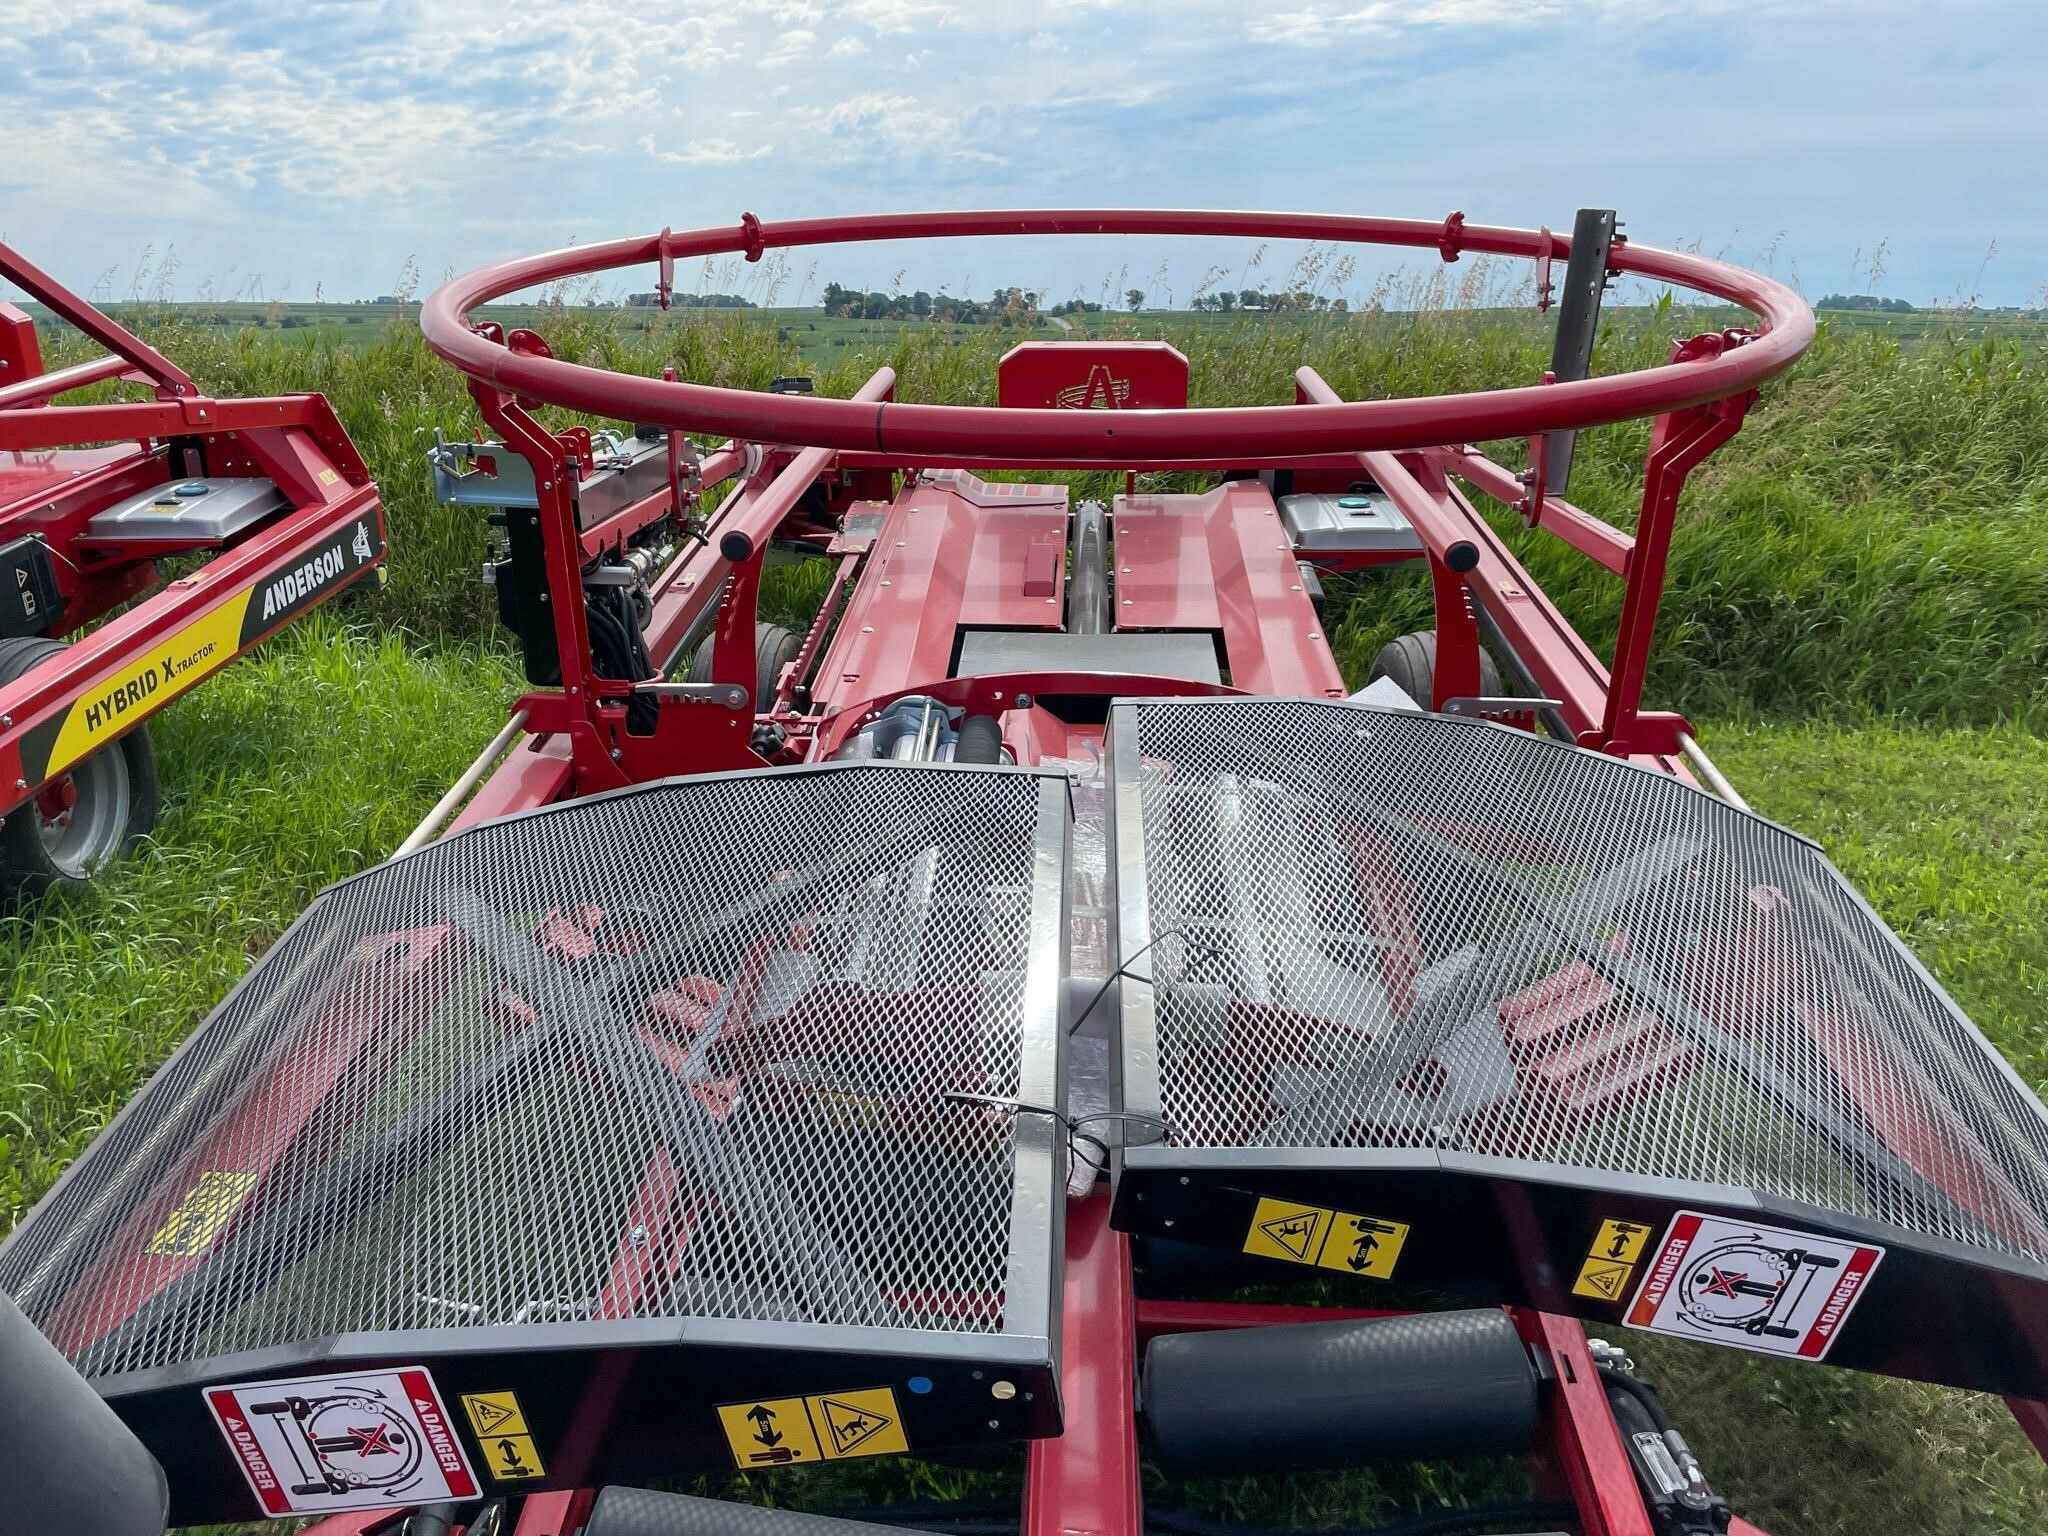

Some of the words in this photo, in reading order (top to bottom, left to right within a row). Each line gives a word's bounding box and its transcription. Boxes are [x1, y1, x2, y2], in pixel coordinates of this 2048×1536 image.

[262, 544, 345, 621] ANDERSON
[85, 668, 158, 733] HYBRID
[1649, 1238, 1689, 1292] DANGER
[1820, 1271, 1863, 1324] DANGER
[233, 1431, 276, 1490] DANGER
[421, 1413, 462, 1473] DANGER
